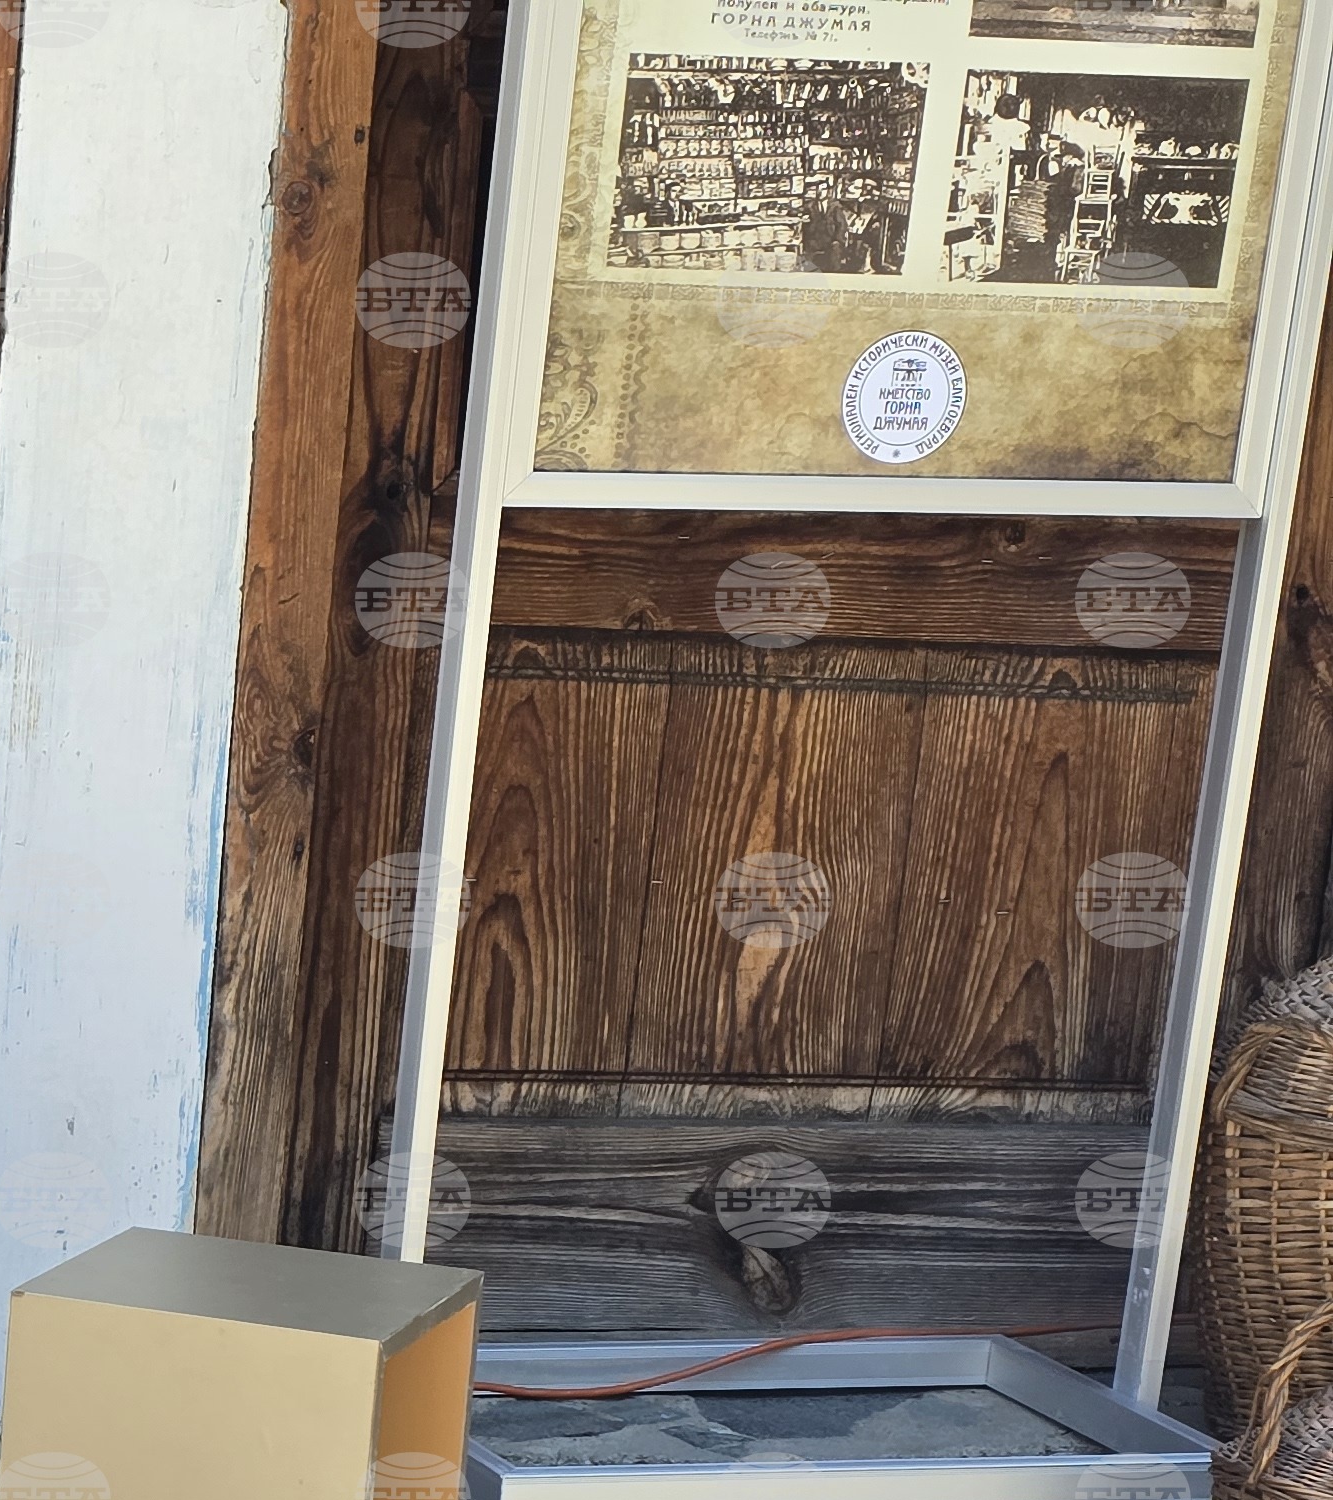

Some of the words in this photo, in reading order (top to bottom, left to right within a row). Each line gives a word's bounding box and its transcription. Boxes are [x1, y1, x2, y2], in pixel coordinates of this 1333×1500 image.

[710, 12, 777, 28] ГОРНА
[783, 16, 871, 32] ДЖУМАЯ
[852, 334, 929, 381] ИСТОРИЧЕСКИ
[878, 387, 931, 401] КМЕТСТВО
[884, 401, 921, 415] ГОРНА
[845, 383, 880, 455] РЕГИОНАЛЕН
[873, 416, 929, 431] ДЖУМАЯ
